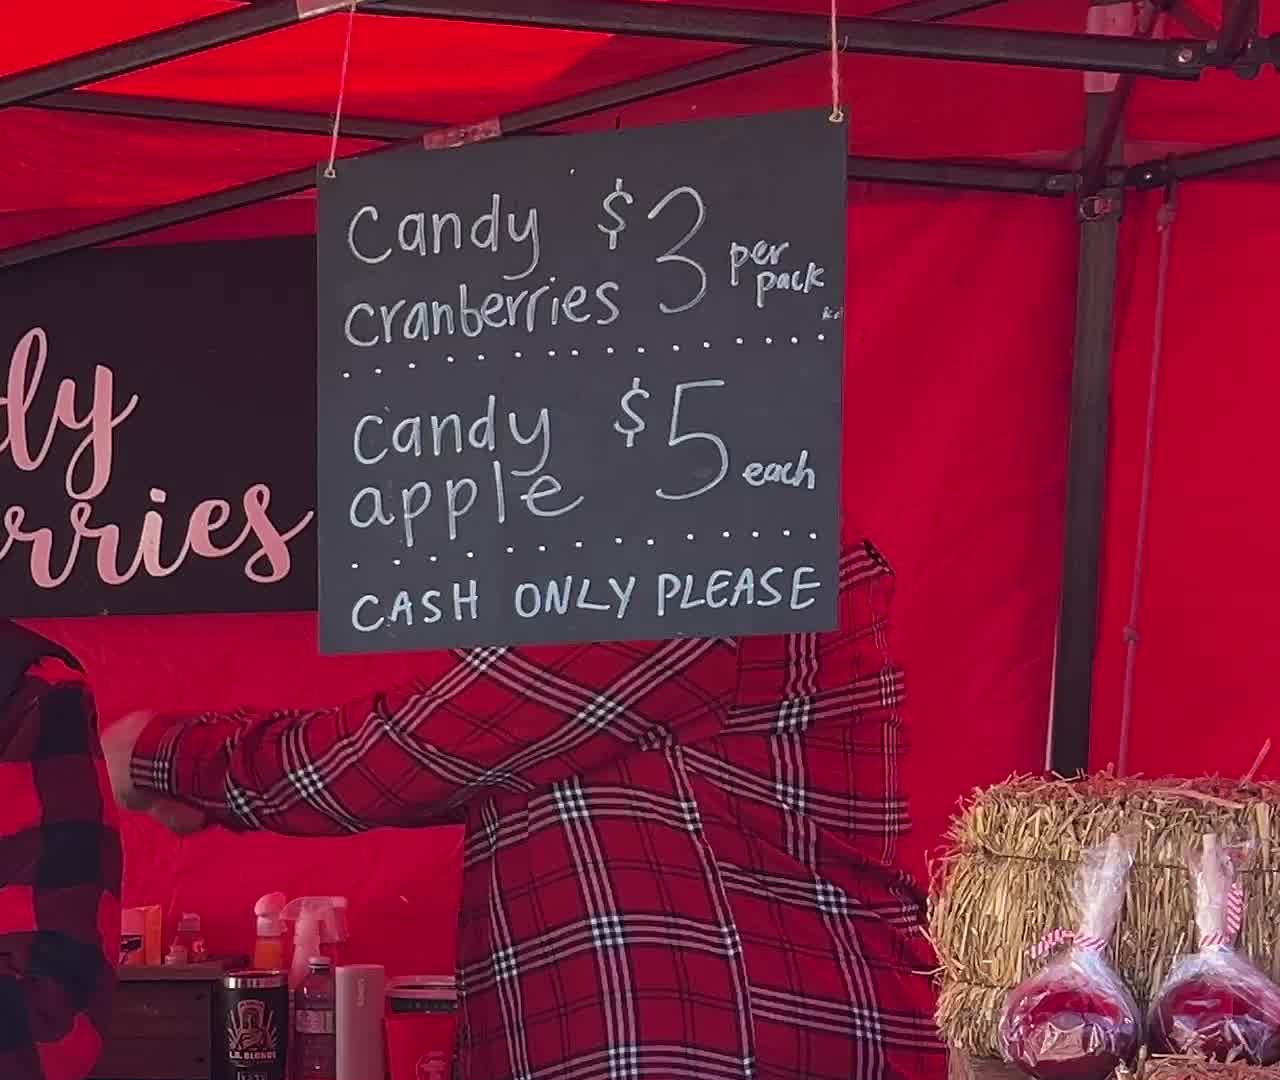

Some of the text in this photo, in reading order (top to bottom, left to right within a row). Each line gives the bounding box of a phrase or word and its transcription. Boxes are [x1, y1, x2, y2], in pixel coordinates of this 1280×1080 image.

[347, 193, 539, 281] Candy
[729, 240, 789, 287] per
[344, 277, 620, 347] cranberries
[756, 262, 825, 308] pack
[741, 450, 816, 489] each
[349, 460, 585, 548] apple
[351, 566, 821, 632] CASH ONLY PLEASE
